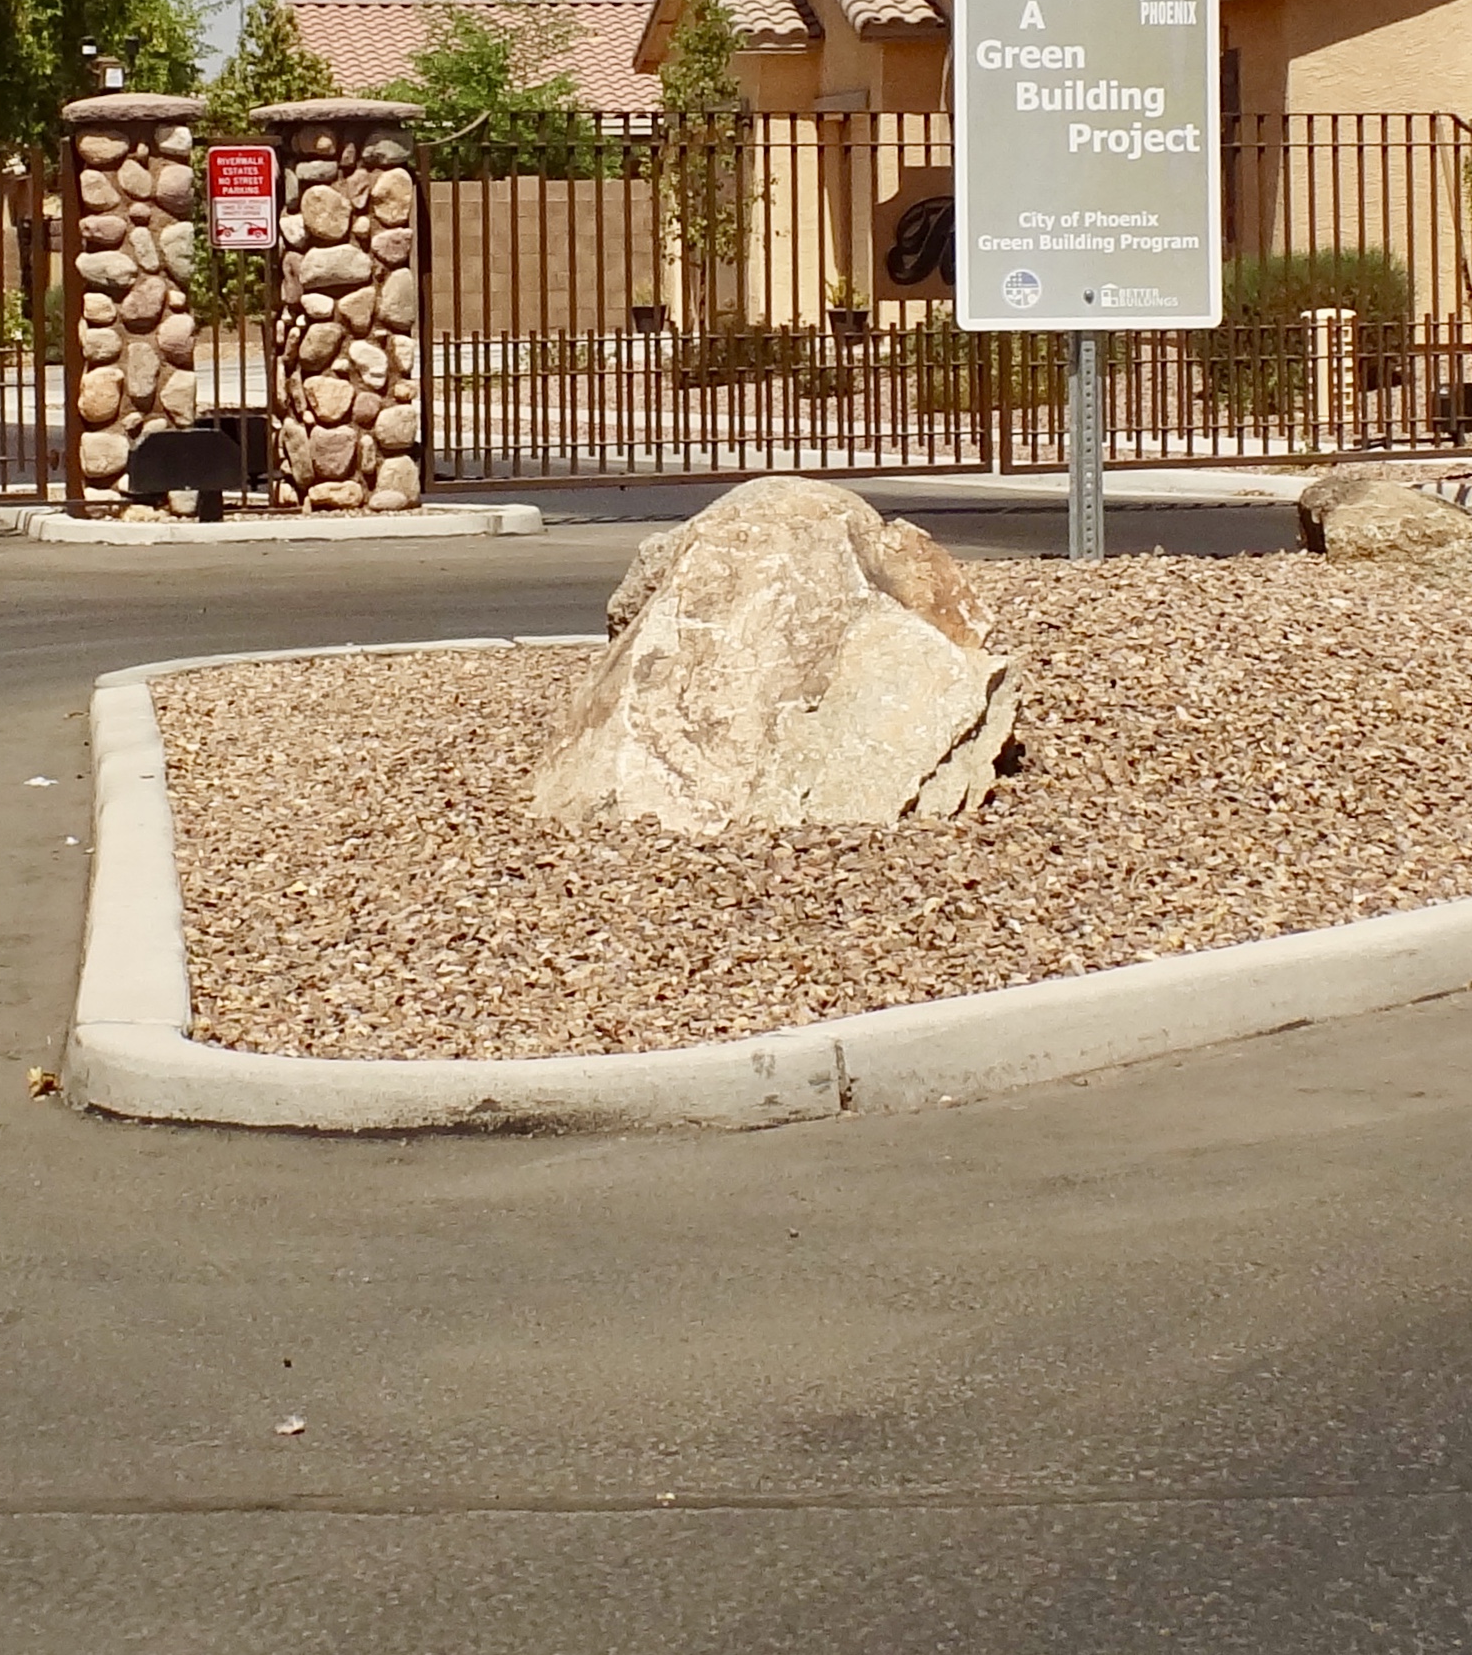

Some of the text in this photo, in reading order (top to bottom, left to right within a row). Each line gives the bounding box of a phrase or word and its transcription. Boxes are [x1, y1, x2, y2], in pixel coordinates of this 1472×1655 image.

[1019, 0, 1046, 30] A
[1140, 0, 1198, 25] PHOENIX
[976, 39, 1086, 70] Green
[1016, 80, 1166, 118] Building
[1068, 122, 1201, 160] Project
[217, 156, 265, 166] RIVERWALK
[222, 166, 259, 176] ESTATES
[233, 176, 264, 185] STREET
[222, 186, 260, 195] PARKING
[1018, 211, 1159, 230] City of Phoenix
[978, 233, 1200, 253] Green Building Program
[1119, 288, 1159, 297] BETTER
[1119, 296, 1179, 307] BUILDINGS
